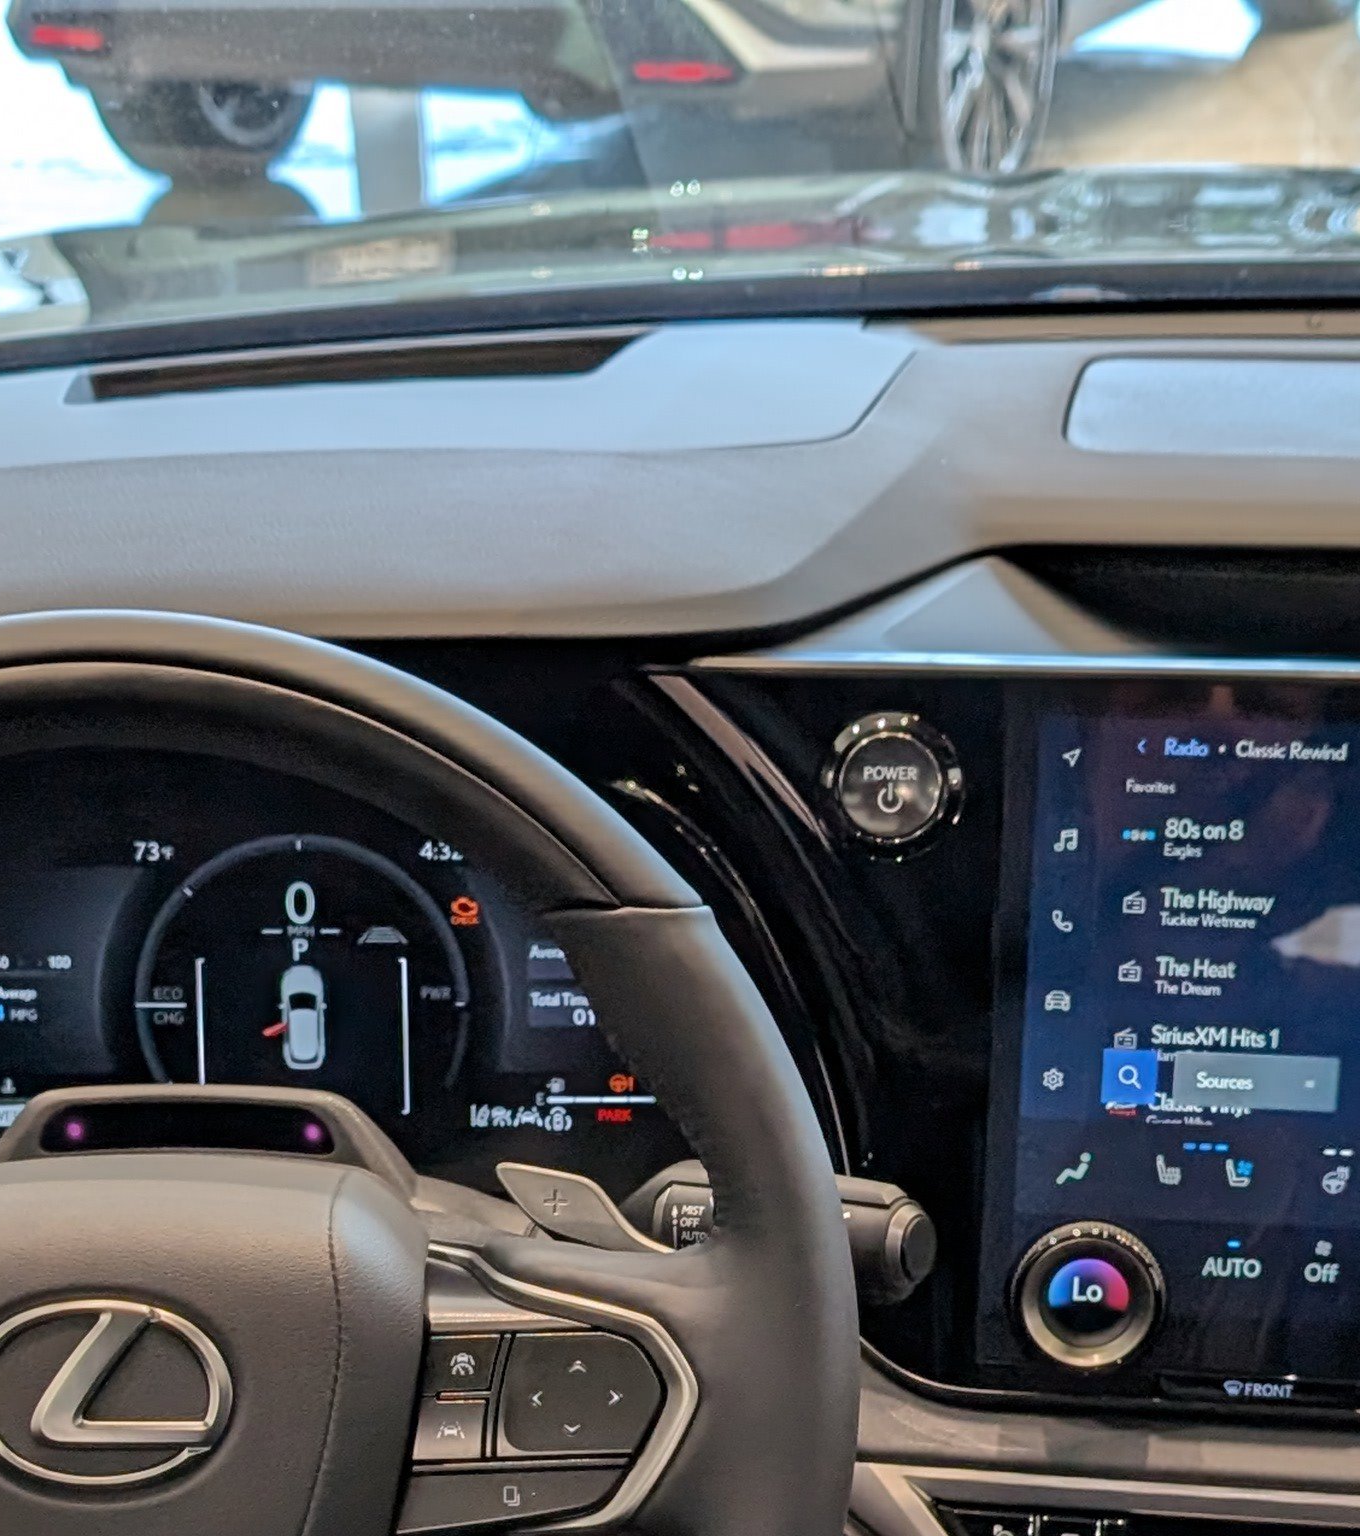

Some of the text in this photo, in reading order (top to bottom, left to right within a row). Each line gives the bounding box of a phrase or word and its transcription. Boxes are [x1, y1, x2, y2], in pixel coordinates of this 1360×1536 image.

[1163, 737, 1349, 762] Radio Classic Rewind
[863, 765, 918, 781] POWER
[1125, 778, 1176, 794] Favorites
[1164, 817, 1201, 840] 80s
[1203, 825, 1226, 841] on
[1228, 819, 1245, 841] 8
[1163, 843, 1202, 860] Eagles
[285, 881, 316, 924] 0
[1160, 886, 1276, 916] The Highway
[1159, 911, 1257, 930] Tucker Wetmore
[292, 938, 309, 961] P
[47, 955, 72, 970] 100
[1155, 956, 1237, 980] The Heat
[152, 986, 183, 1000] ECO
[419, 985, 451, 1000] PWR
[1155, 979, 1222, 997] The Dream
[530, 991, 560, 1007] Total
[9, 1009, 38, 1022] MPG
[152, 1012, 185, 1026] CHG
[1151, 1024, 1280, 1049] SiriusXM Hits 1
[1196, 1071, 1254, 1090] Sources
[596, 1108, 633, 1123] PARK
[681, 1204, 706, 1216] MIST
[680, 1216, 701, 1228] OFF
[1201, 1257, 1263, 1279] AUTO
[1303, 1261, 1341, 1284] Off
[1072, 1275, 1104, 1303] Lo
[1242, 1381, 1294, 1399] FRONT
